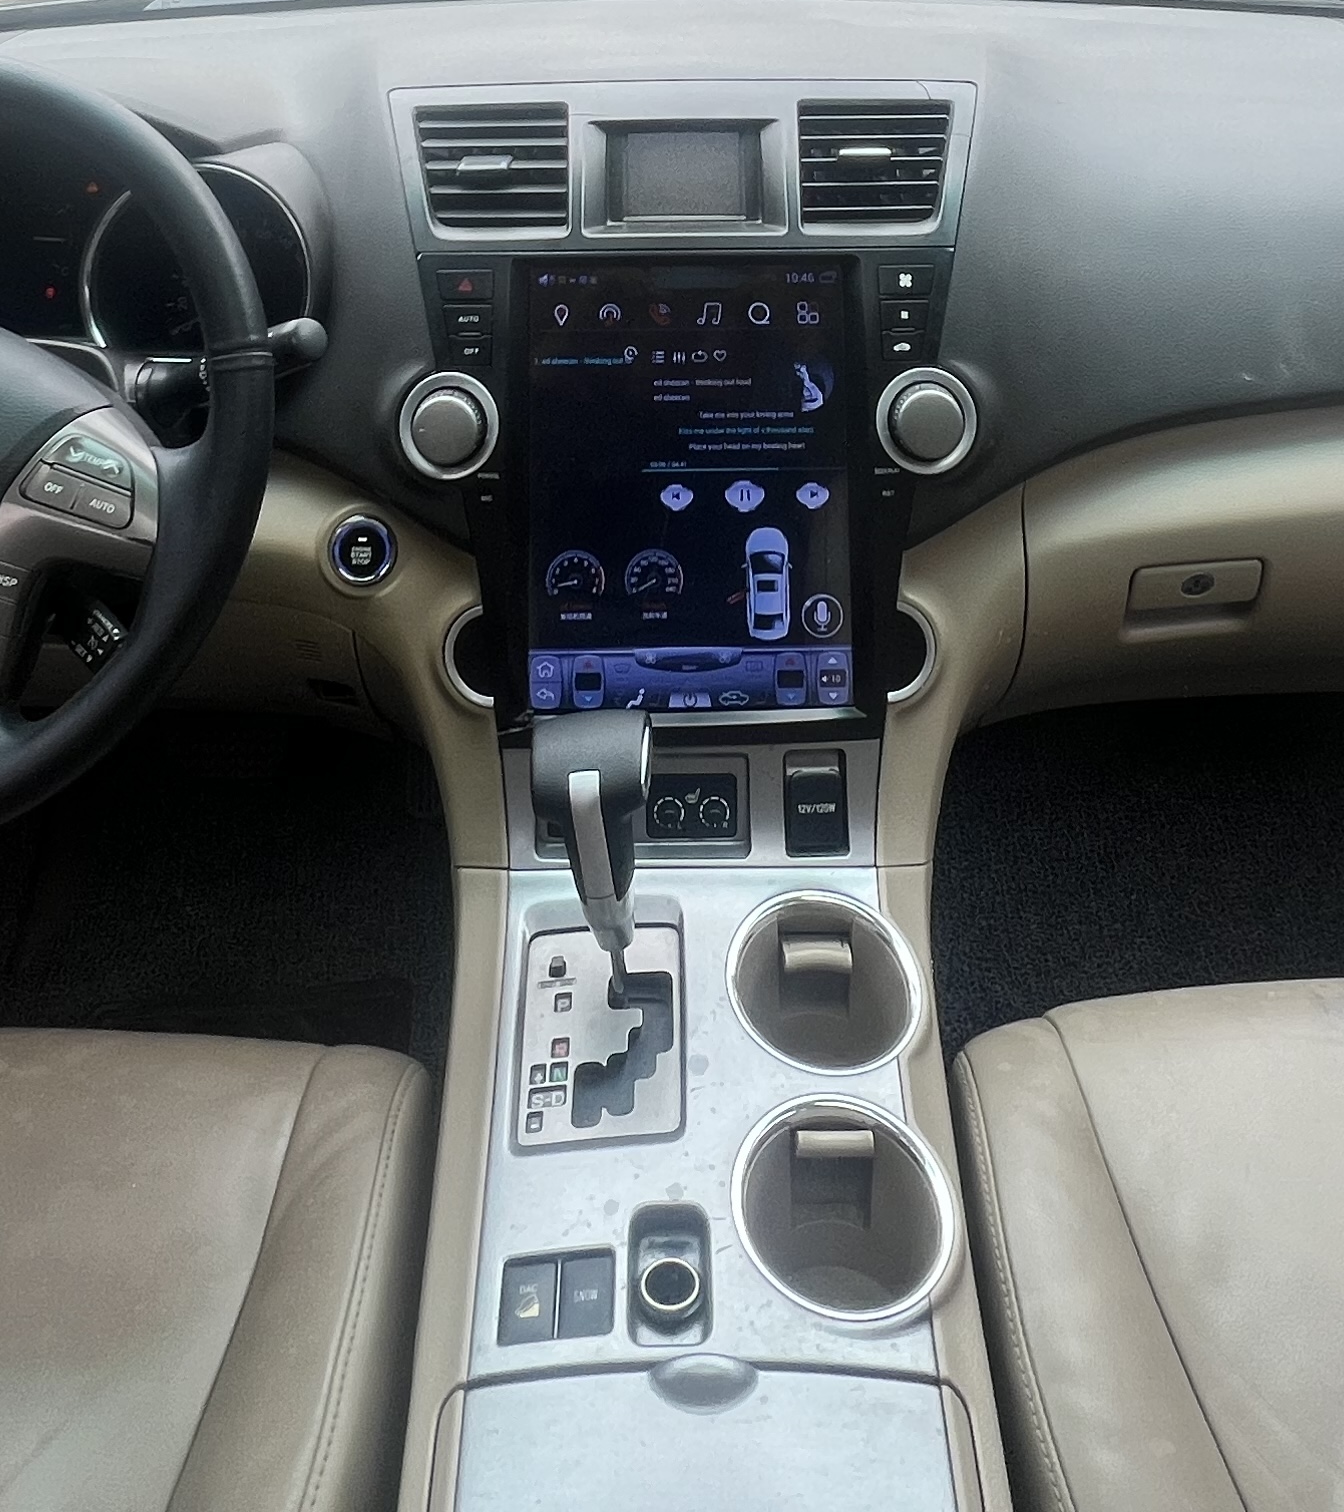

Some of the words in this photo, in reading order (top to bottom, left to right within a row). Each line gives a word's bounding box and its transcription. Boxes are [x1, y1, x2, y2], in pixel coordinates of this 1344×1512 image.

[458, 315, 479, 323] AUTO
[463, 347, 479, 355] OFF
[82, 451, 105, 467] TEMP
[43, 481, 64, 495] OFF
[89, 498, 116, 514] AUTO
[557, 998, 570, 1012] P
[554, 1067, 566, 1081] N
[519, 1284, 538, 1295] DAC
[574, 1289, 599, 1303] SNOW
